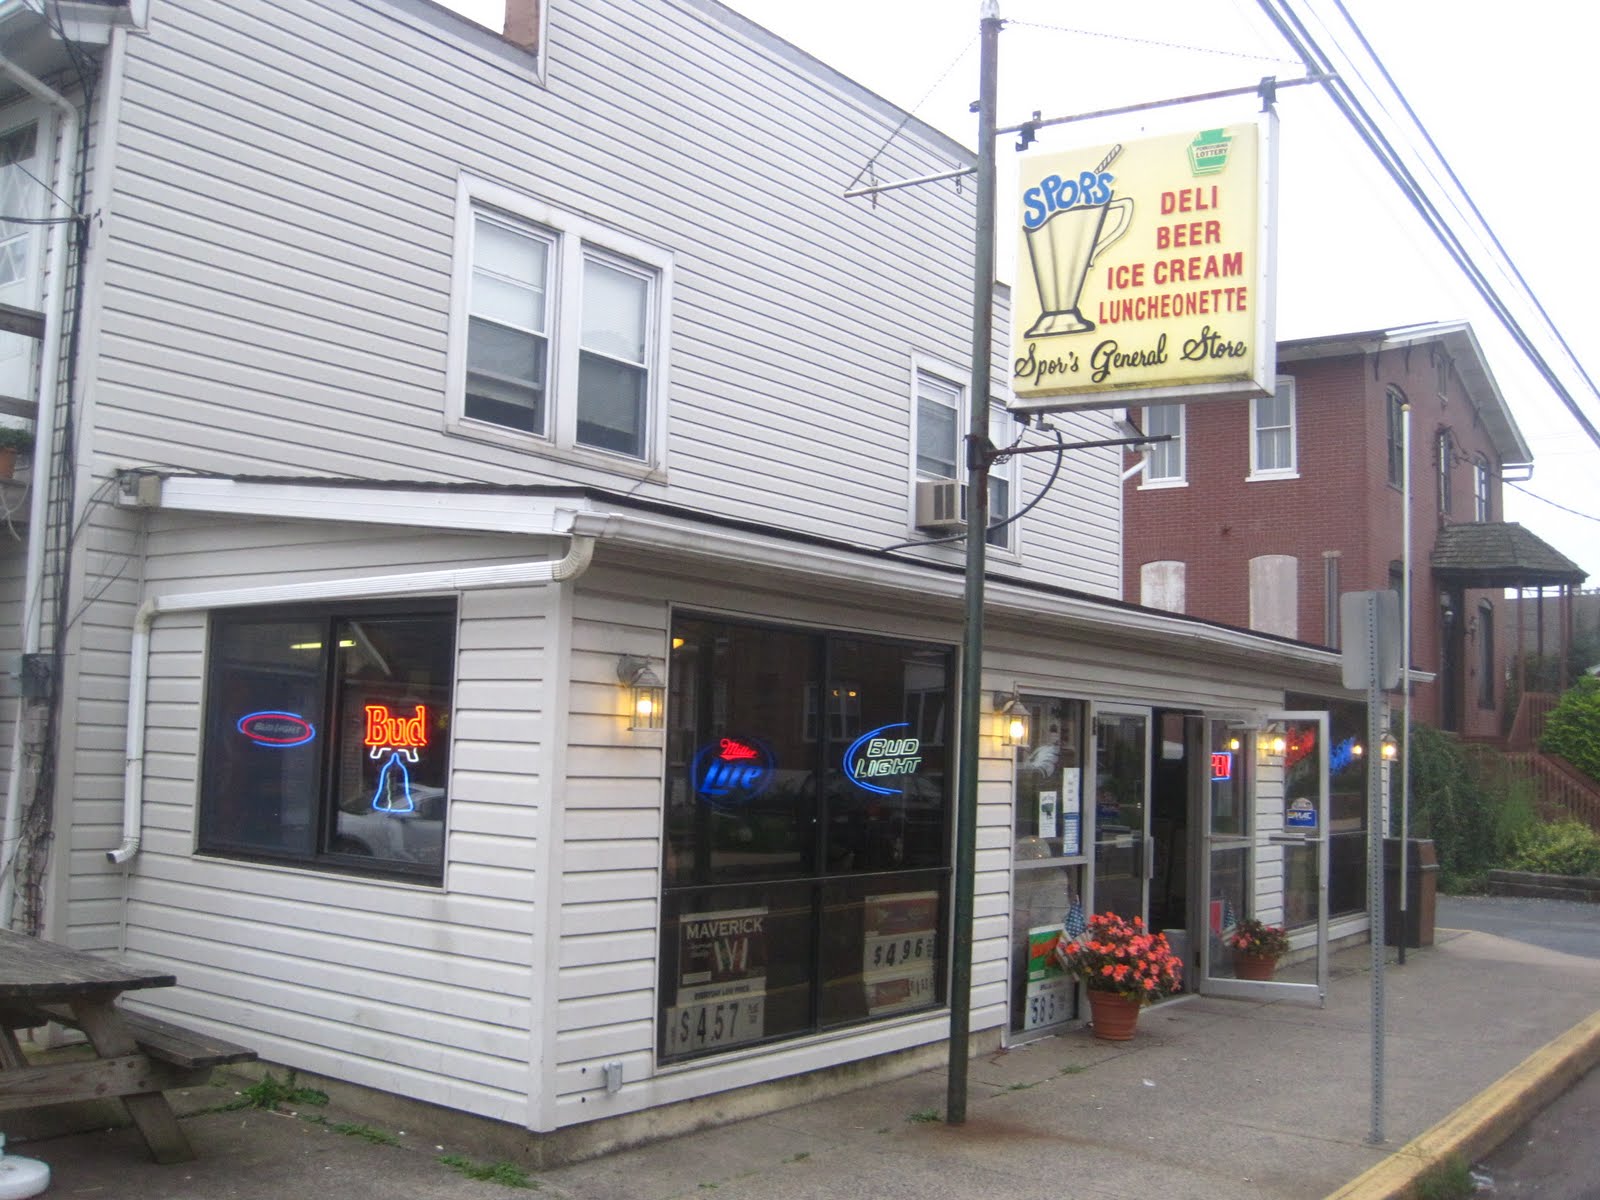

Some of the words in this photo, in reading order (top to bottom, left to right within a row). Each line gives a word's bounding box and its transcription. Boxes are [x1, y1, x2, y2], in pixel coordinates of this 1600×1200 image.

[1196, 148, 1228, 159] LOTTERY
[1023, 171, 1115, 228] SPORS
[1160, 185, 1219, 216] DELI
[1156, 219, 1222, 250] BEER
[1107, 263, 1146, 291] ICE
[1153, 251, 1244, 286] CREAM
[1099, 286, 1248, 325] LUNCHEONETTE
[1014, 342, 1080, 386] Spor's
[1091, 333, 1168, 384] General
[1180, 325, 1247, 361] Store
[365, 704, 426, 745] Bud
[719, 738, 759, 760] Miller
[867, 738, 920, 757] BUD
[854, 757, 923, 779] LIGHT
[686, 917, 764, 940] MAVERICK
